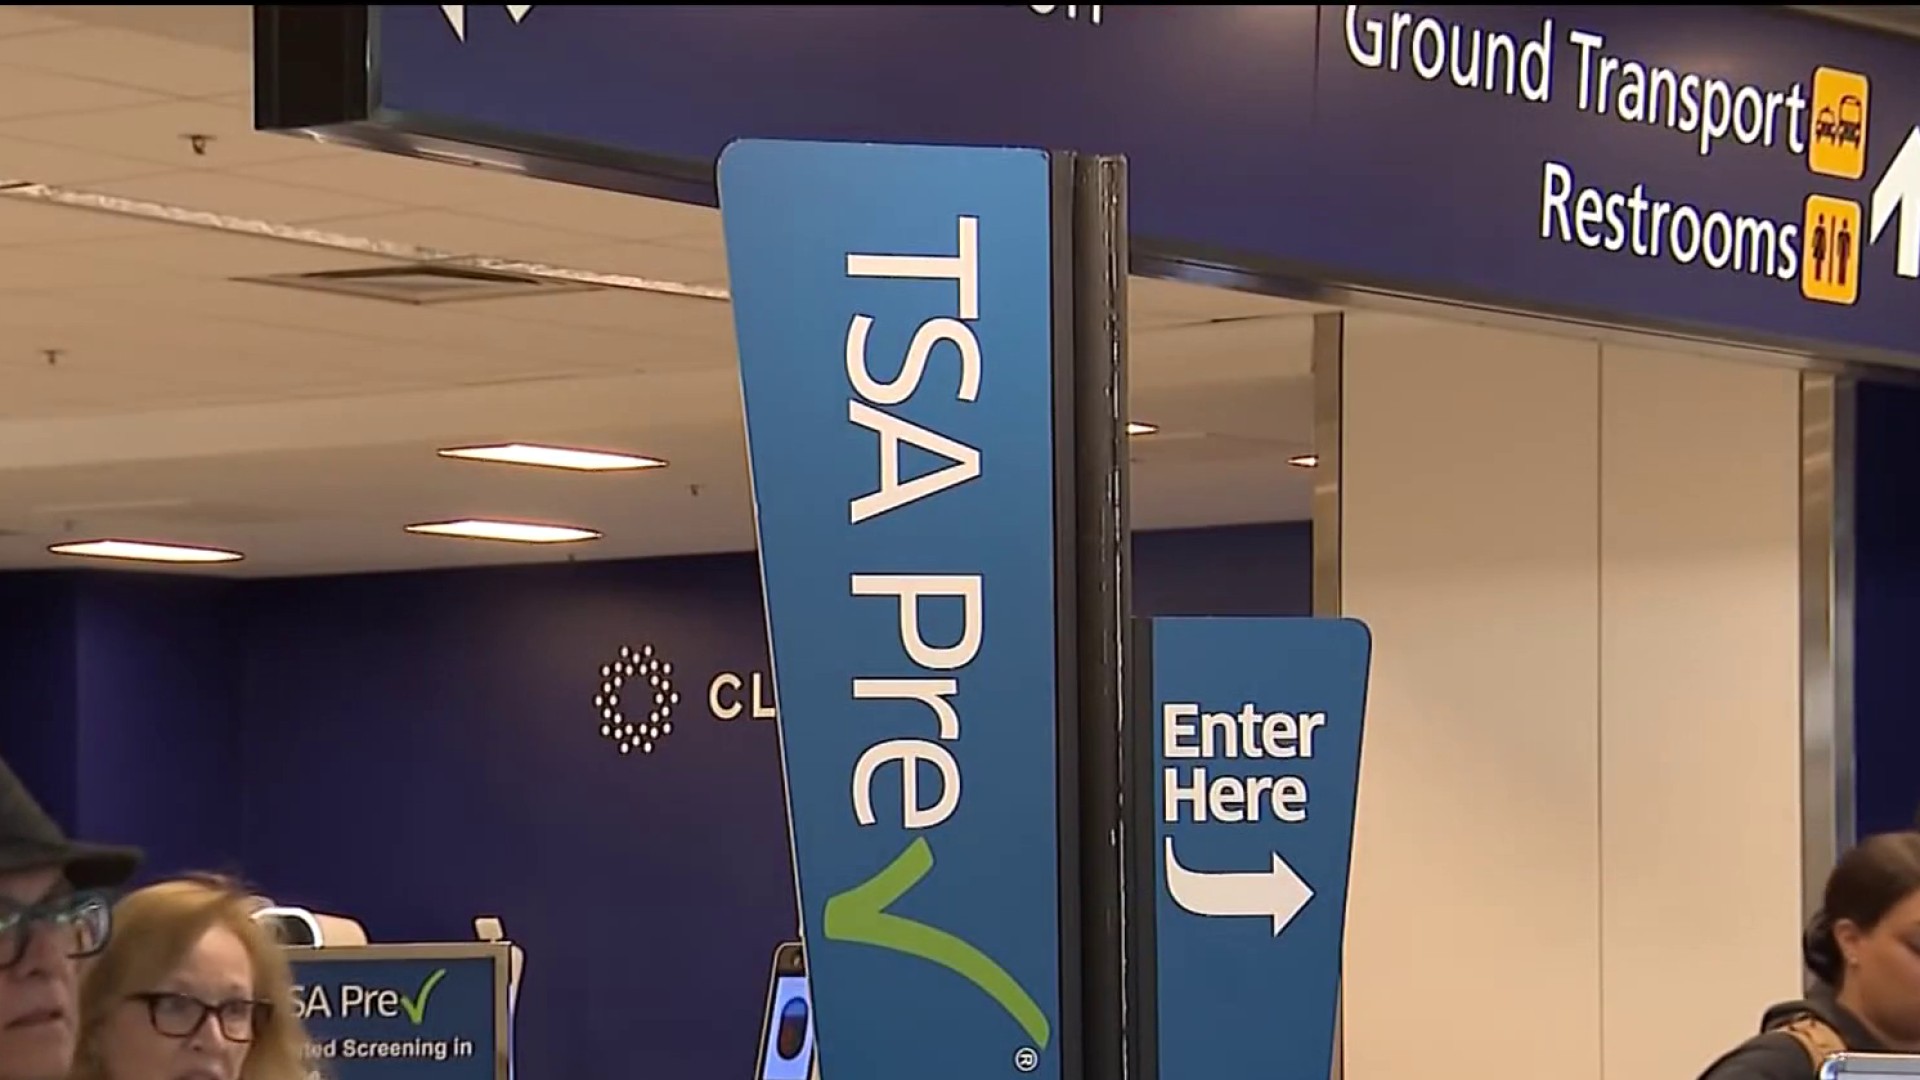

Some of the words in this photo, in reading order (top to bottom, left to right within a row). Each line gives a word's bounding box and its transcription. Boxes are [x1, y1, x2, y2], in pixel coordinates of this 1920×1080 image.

[1345, 5, 1553, 102] Ground
[1569, 31, 1806, 155] Transport
[1540, 162, 1798, 280] Restrooms
[846, 215, 982, 525] TSA
[709, 672, 776, 719] CL
[852, 574, 983, 829] Pre
[1163, 703, 1326, 758] Enter
[1164, 767, 1307, 822] Here
[341, 985, 399, 1019] Pre
[342, 1037, 447, 1061] Screening
[453, 1036, 473, 1057] in
